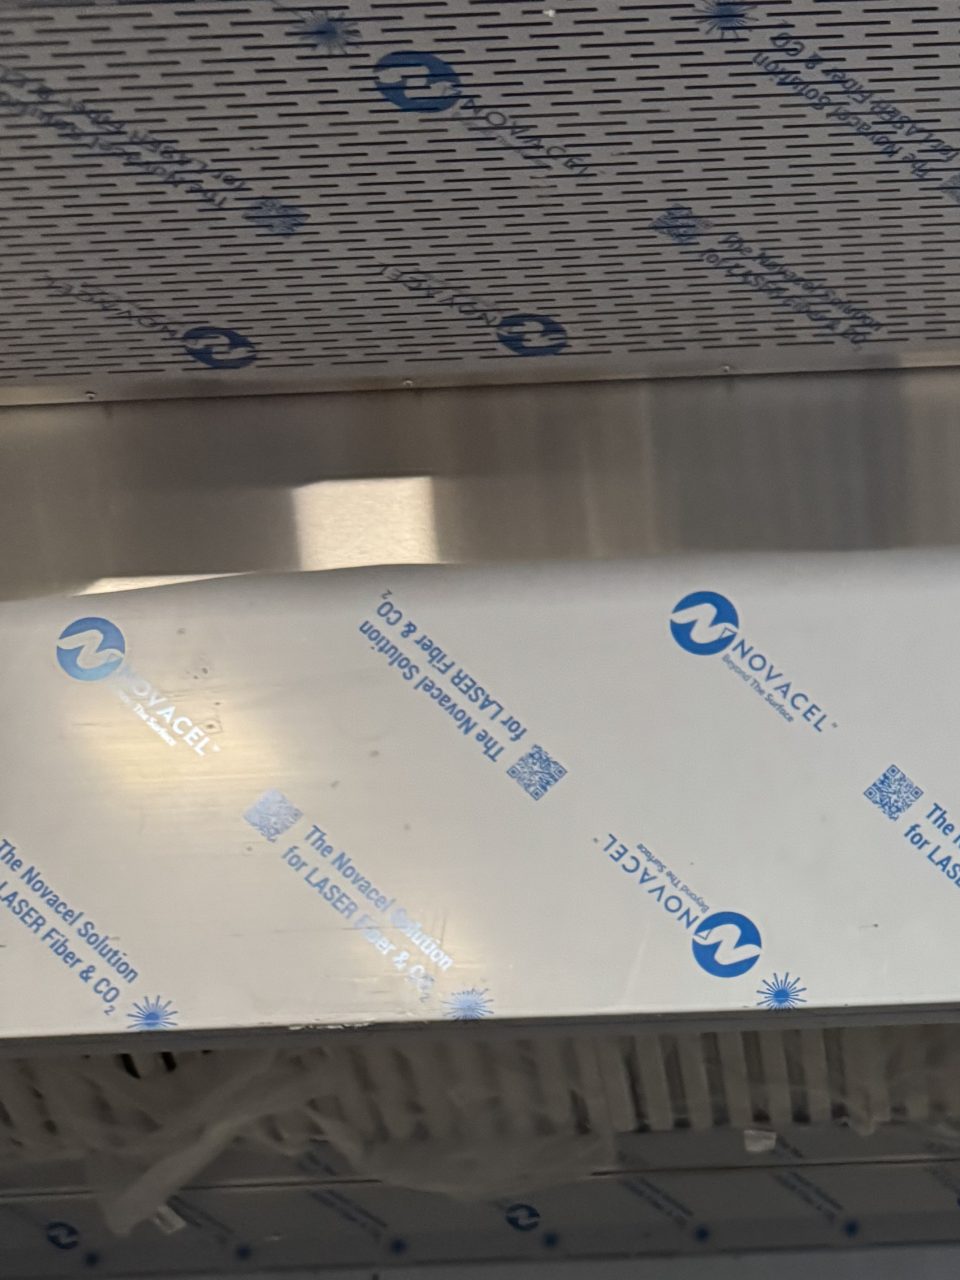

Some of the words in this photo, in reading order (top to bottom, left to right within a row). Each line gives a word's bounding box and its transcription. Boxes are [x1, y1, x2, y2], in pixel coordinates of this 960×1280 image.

[359, 620, 420, 682] Solution
[400, 620, 418, 639] &
[414, 634, 456, 676] Fiber
[121, 661, 211, 756] OVACEL
[413, 675, 478, 736] Novacel
[450, 668, 506, 721] LASER
[731, 638, 828, 733] NOVACEL
[764, 692, 795, 723] Surface
[475, 728, 505, 763] The
[500, 715, 528, 743] for
[903, 823, 932, 851] for
[926, 802, 955, 837] The
[281, 845, 309, 872] for
[304, 867, 359, 920] LASER
[304, 824, 334, 858] The
[331, 851, 397, 912] Novacel
[603, 833, 700, 929] NOVACEL
[0, 839, 23, 872] The
[20, 866, 84, 926] Novacel
[77, 920, 139, 983] Solution
[41, 927, 83, 968] Fiber
[79, 964, 96, 983] &
